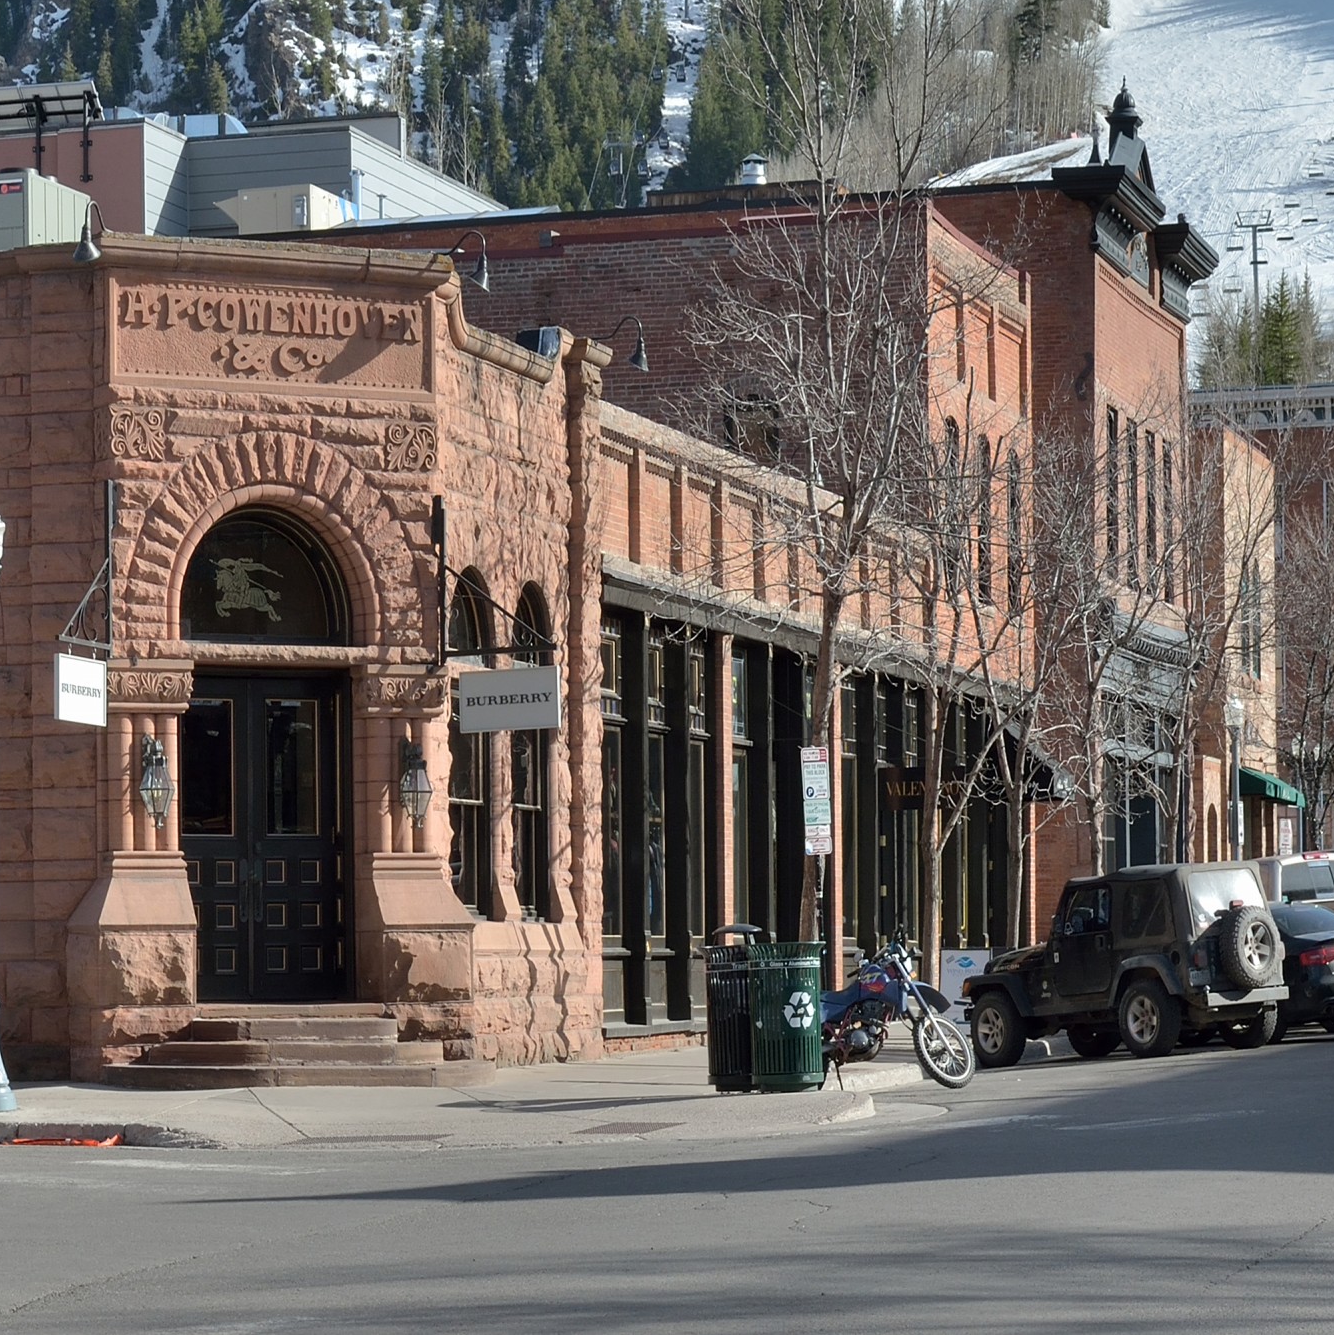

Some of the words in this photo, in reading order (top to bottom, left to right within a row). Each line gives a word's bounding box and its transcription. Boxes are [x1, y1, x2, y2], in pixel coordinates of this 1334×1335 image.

[61, 683, 102, 698] BURBERRY
[466, 692, 552, 706] BURBERRY
[886, 781, 959, 796] VALENNO
